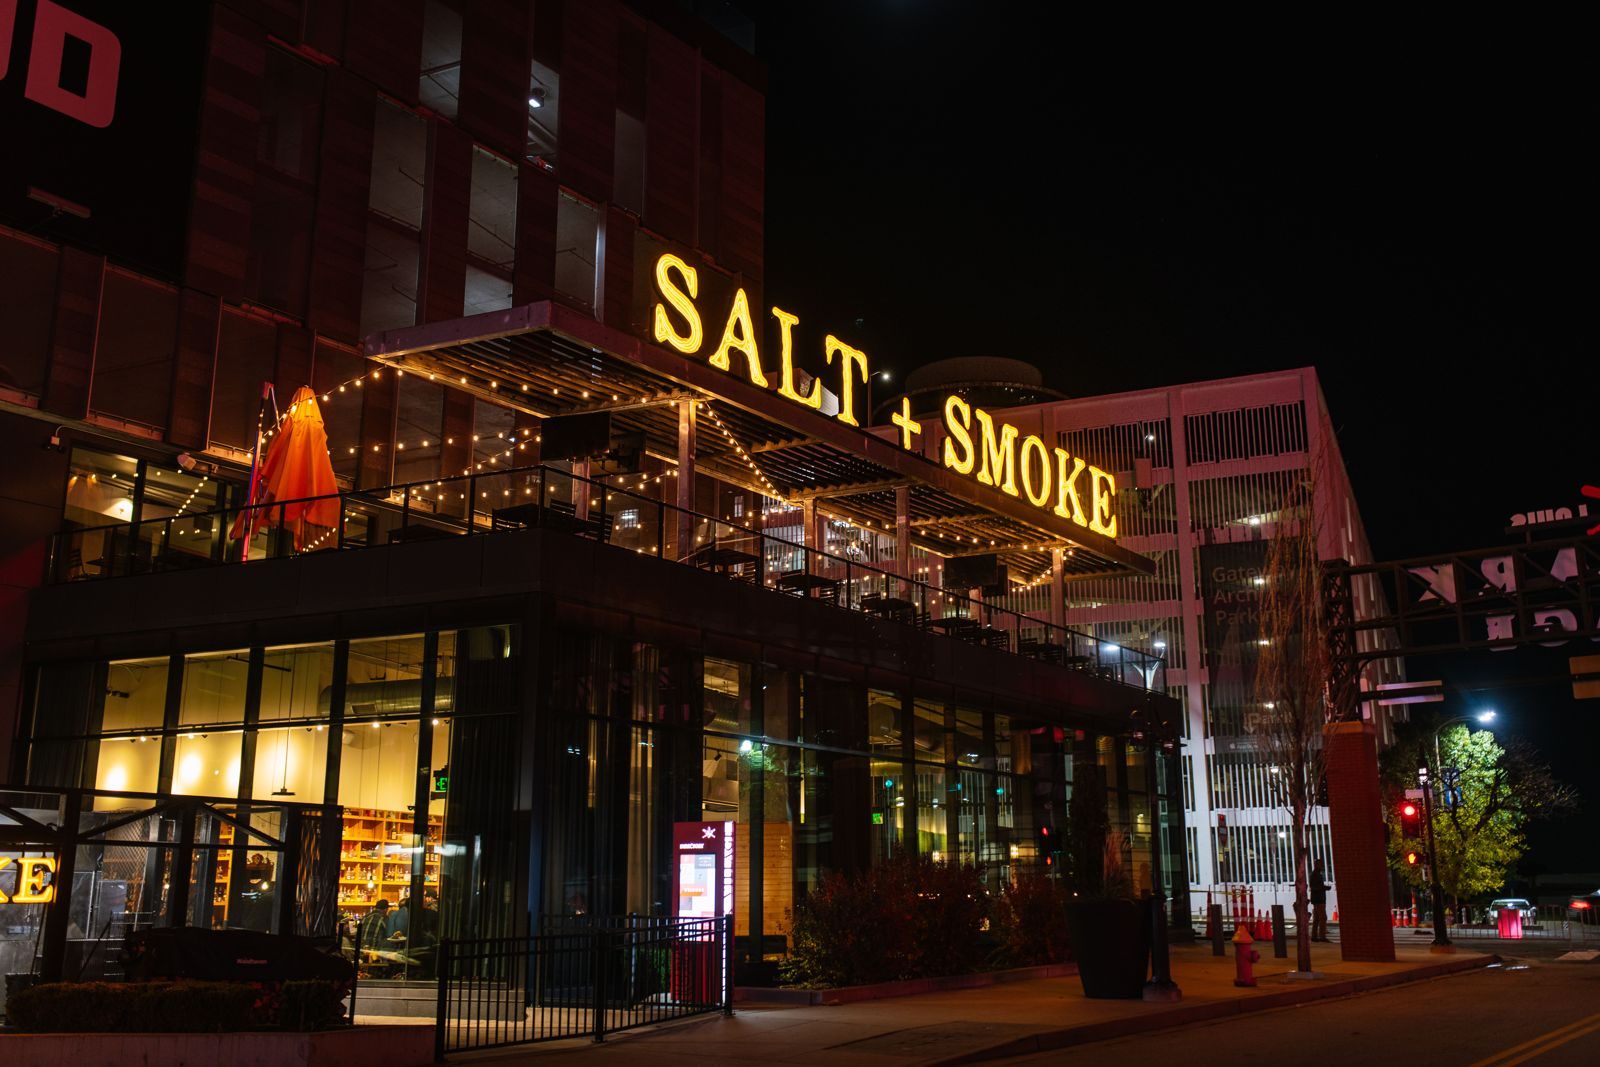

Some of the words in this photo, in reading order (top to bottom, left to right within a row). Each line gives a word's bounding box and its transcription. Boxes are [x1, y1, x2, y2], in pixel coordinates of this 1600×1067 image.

[0, 0, 123, 129] D
[655, 252, 868, 427] SALT
[944, 394, 1118, 538] SMOKE
